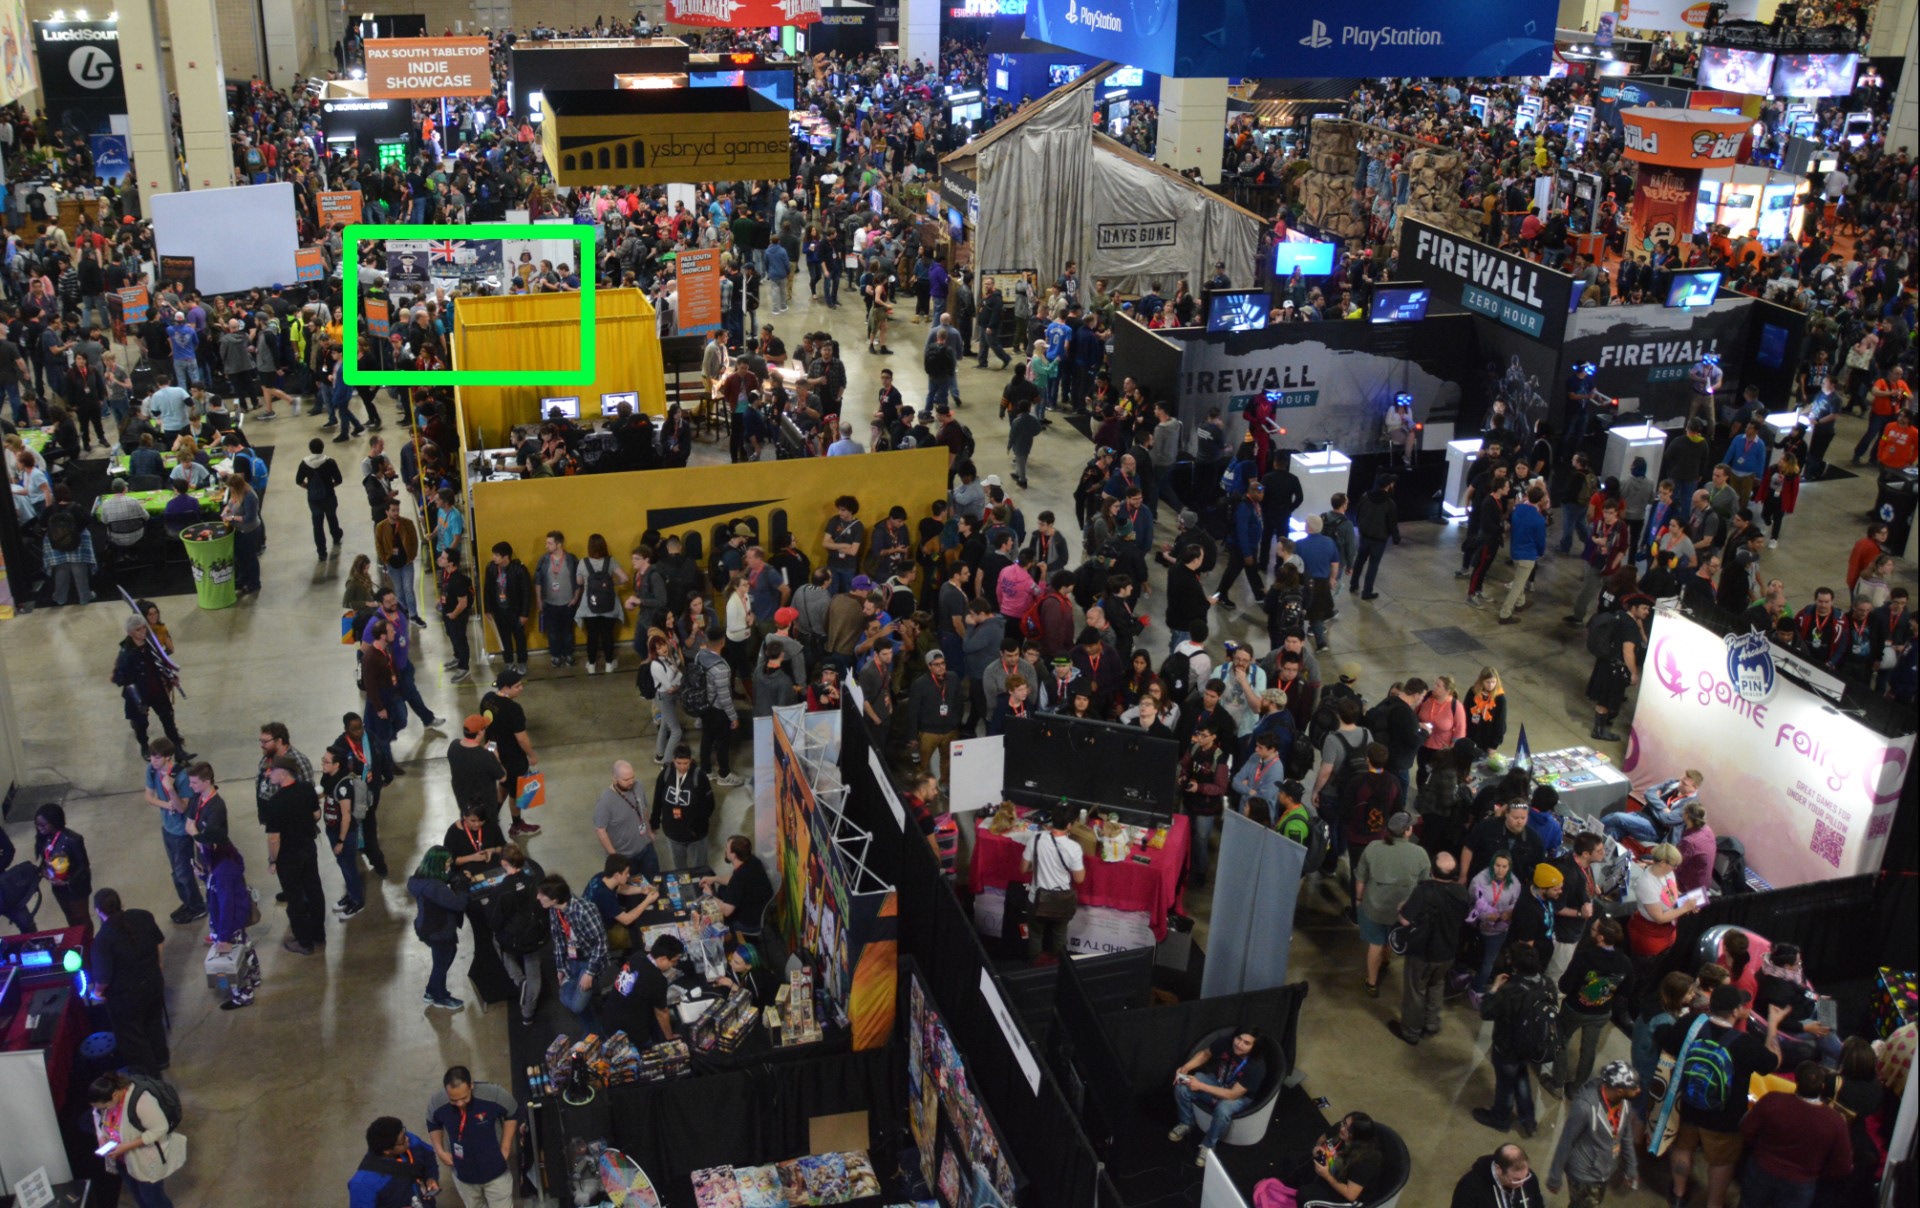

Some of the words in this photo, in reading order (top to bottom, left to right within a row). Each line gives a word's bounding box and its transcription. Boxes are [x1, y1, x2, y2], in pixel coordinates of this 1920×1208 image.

[884, 7, 899, 17] R.P.
[1080, 6, 1122, 32] PlayStation
[821, 15, 864, 25] CAPCOM
[42, 28, 119, 42] LucidSoun
[1341, 26, 1441, 51] PlayStation
[368, 49, 389, 58] PAX
[391, 48, 430, 58] SOUTH
[431, 47, 485, 57] TABLETOP
[408, 61, 448, 74] INDIE
[386, 75, 472, 89] SHOWCASE
[650, 132, 716, 167] ysbryd
[723, 139, 788, 166] games
[1649, 170, 1685, 191] RAPTURE
[1103, 229, 1137, 243] DAYS
[1139, 226, 1171, 242] GONE
[680, 255, 693, 263] PAX
[693, 253, 712, 261] SOUTH
[681, 266, 712, 275] SHOWCASE
[1416, 229, 1543, 309] FIREWALL
[1469, 291, 1498, 313] ZERO
[1503, 306, 1536, 330] HOUR
[1180, 364, 1316, 395] IREWALL
[1655, 368, 1683, 379] ZERO
[1277, 394, 1311, 405] HOUR
[1741, 680, 1762, 692] PIN
[1796, 780, 1816, 798] GREAT
[1816, 792, 1838, 814] GAMES
[1838, 806, 1852, 822] FOR
[1786, 787, 1808, 807] UNDER
[1807, 802, 1825, 818] YOUR
[1824, 812, 1849, 834] PILLOW
[1084, 939, 1100, 951] TV
